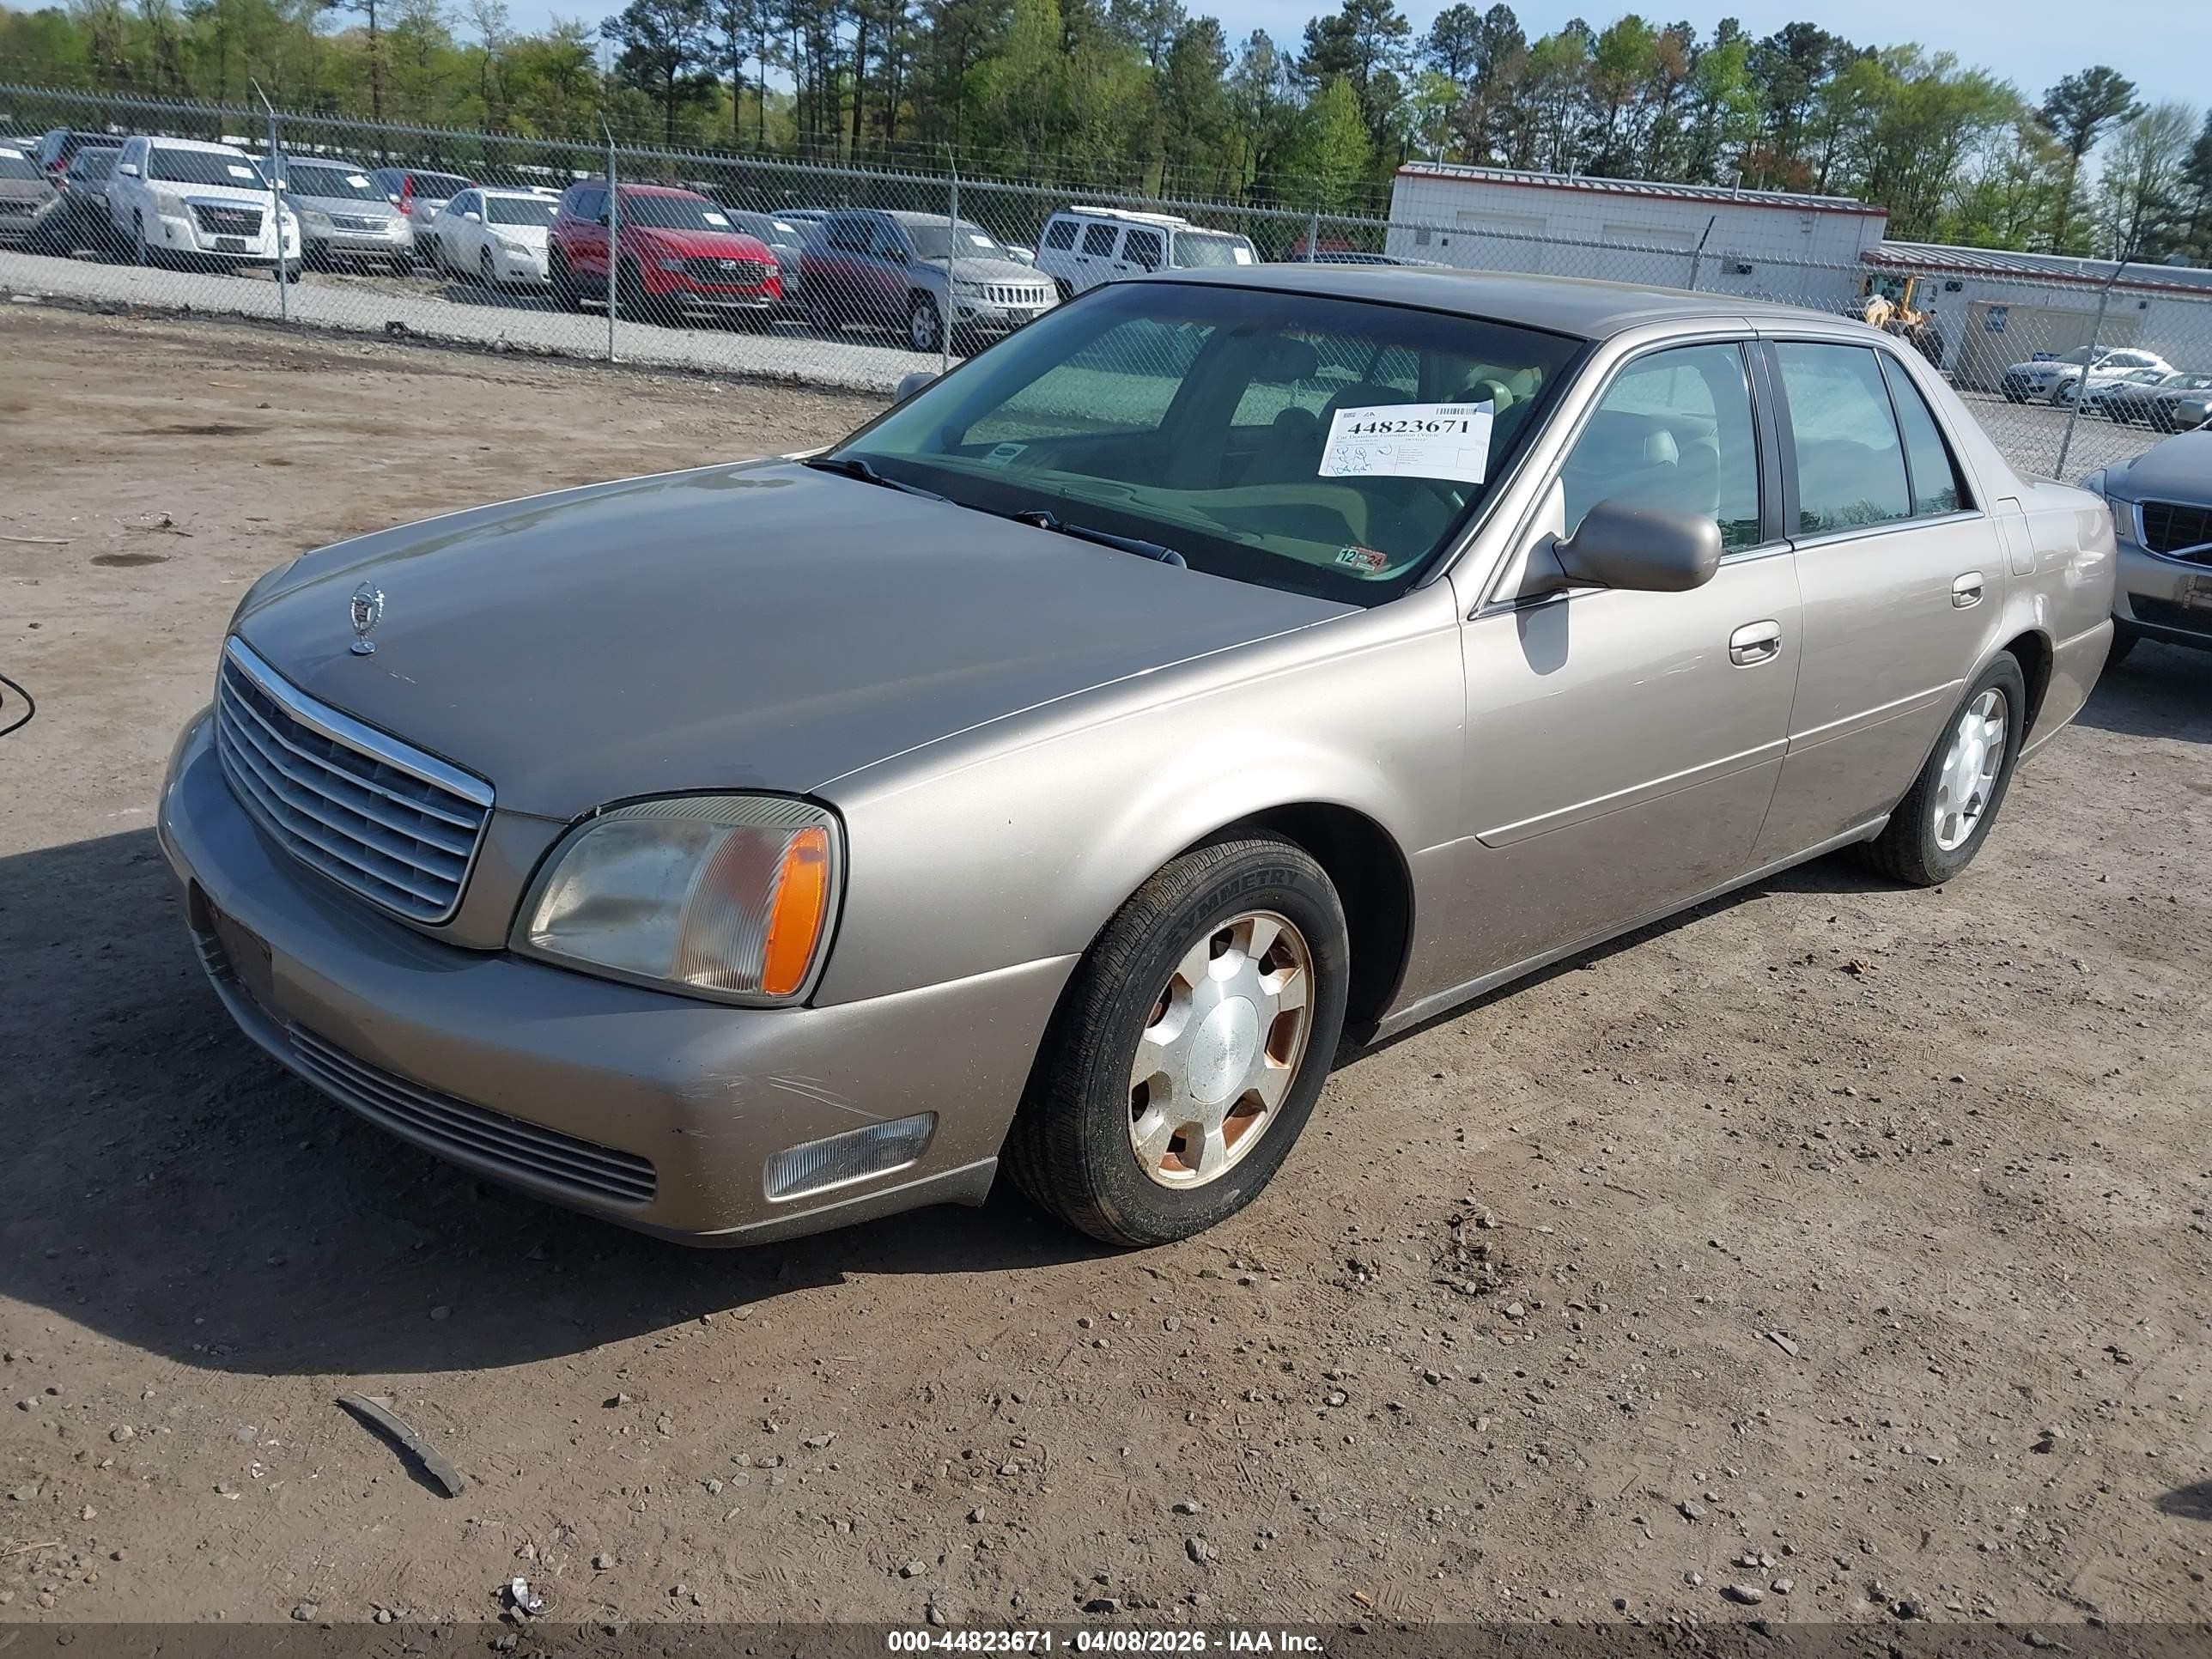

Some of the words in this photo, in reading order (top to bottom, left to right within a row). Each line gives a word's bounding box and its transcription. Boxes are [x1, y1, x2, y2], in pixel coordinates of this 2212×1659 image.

[1347, 420, 1469, 434] 44823671
[1340, 550, 1356, 563] 12
[1367, 556, 1383, 567] 24
[1166, 868, 1299, 950] SYMMETRY
